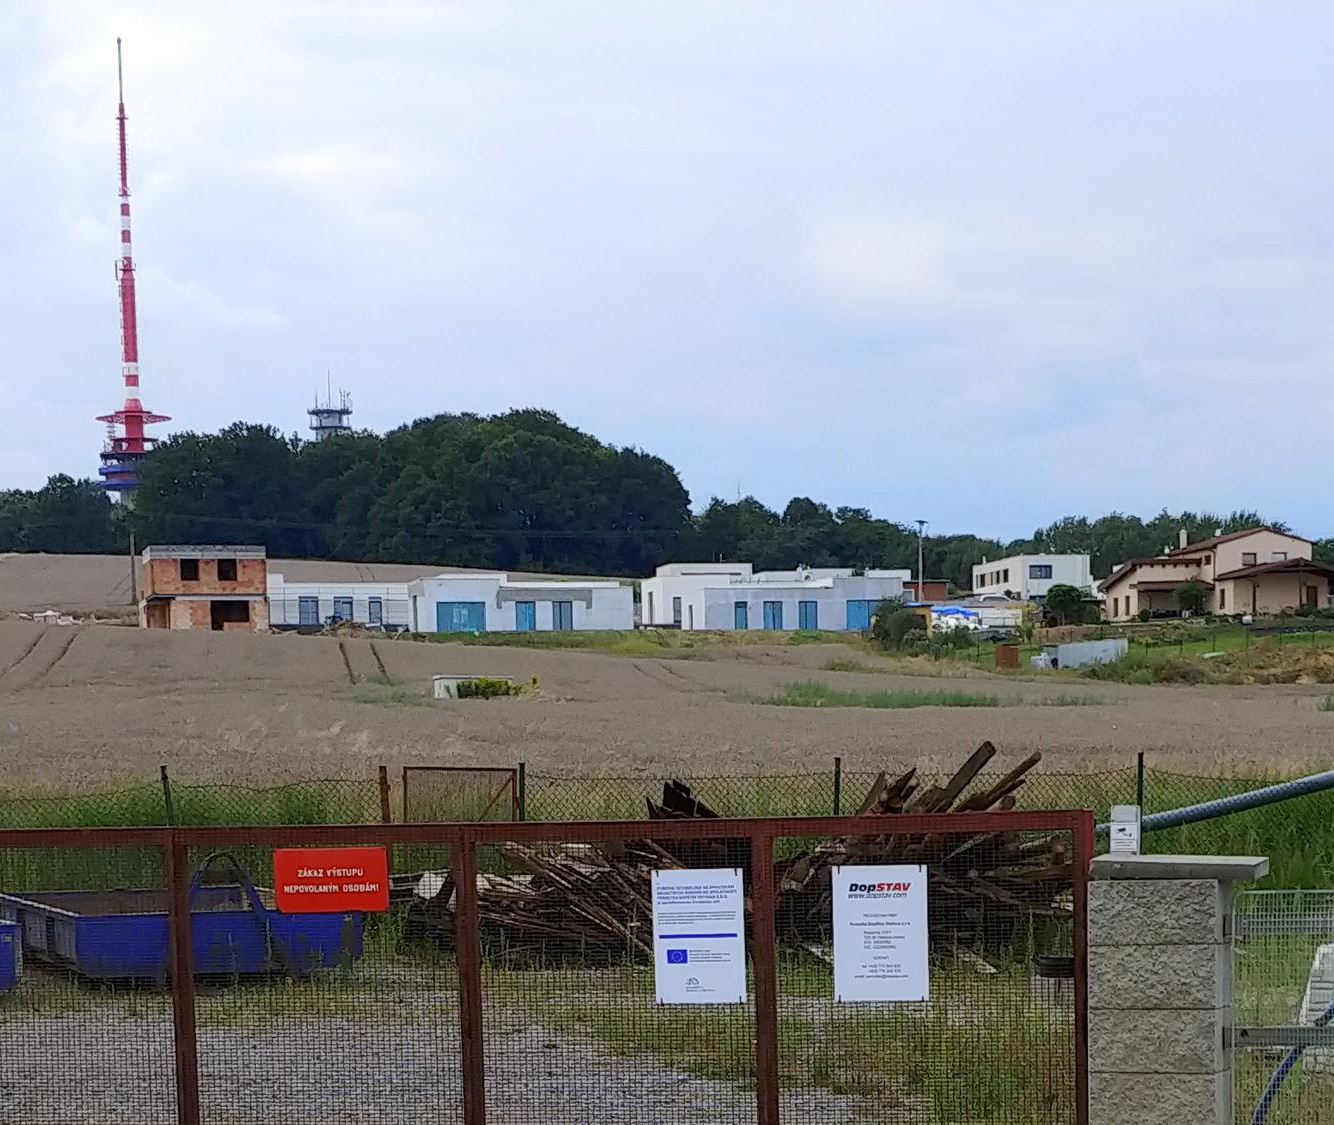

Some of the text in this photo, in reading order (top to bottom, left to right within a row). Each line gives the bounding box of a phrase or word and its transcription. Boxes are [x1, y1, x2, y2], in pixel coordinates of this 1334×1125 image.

[298, 867, 323, 877] ZÁKAZ
[284, 882, 379, 893] NEPOVOLANÝM OSOBÁM!
[849, 883, 911, 893] DopSTAV
